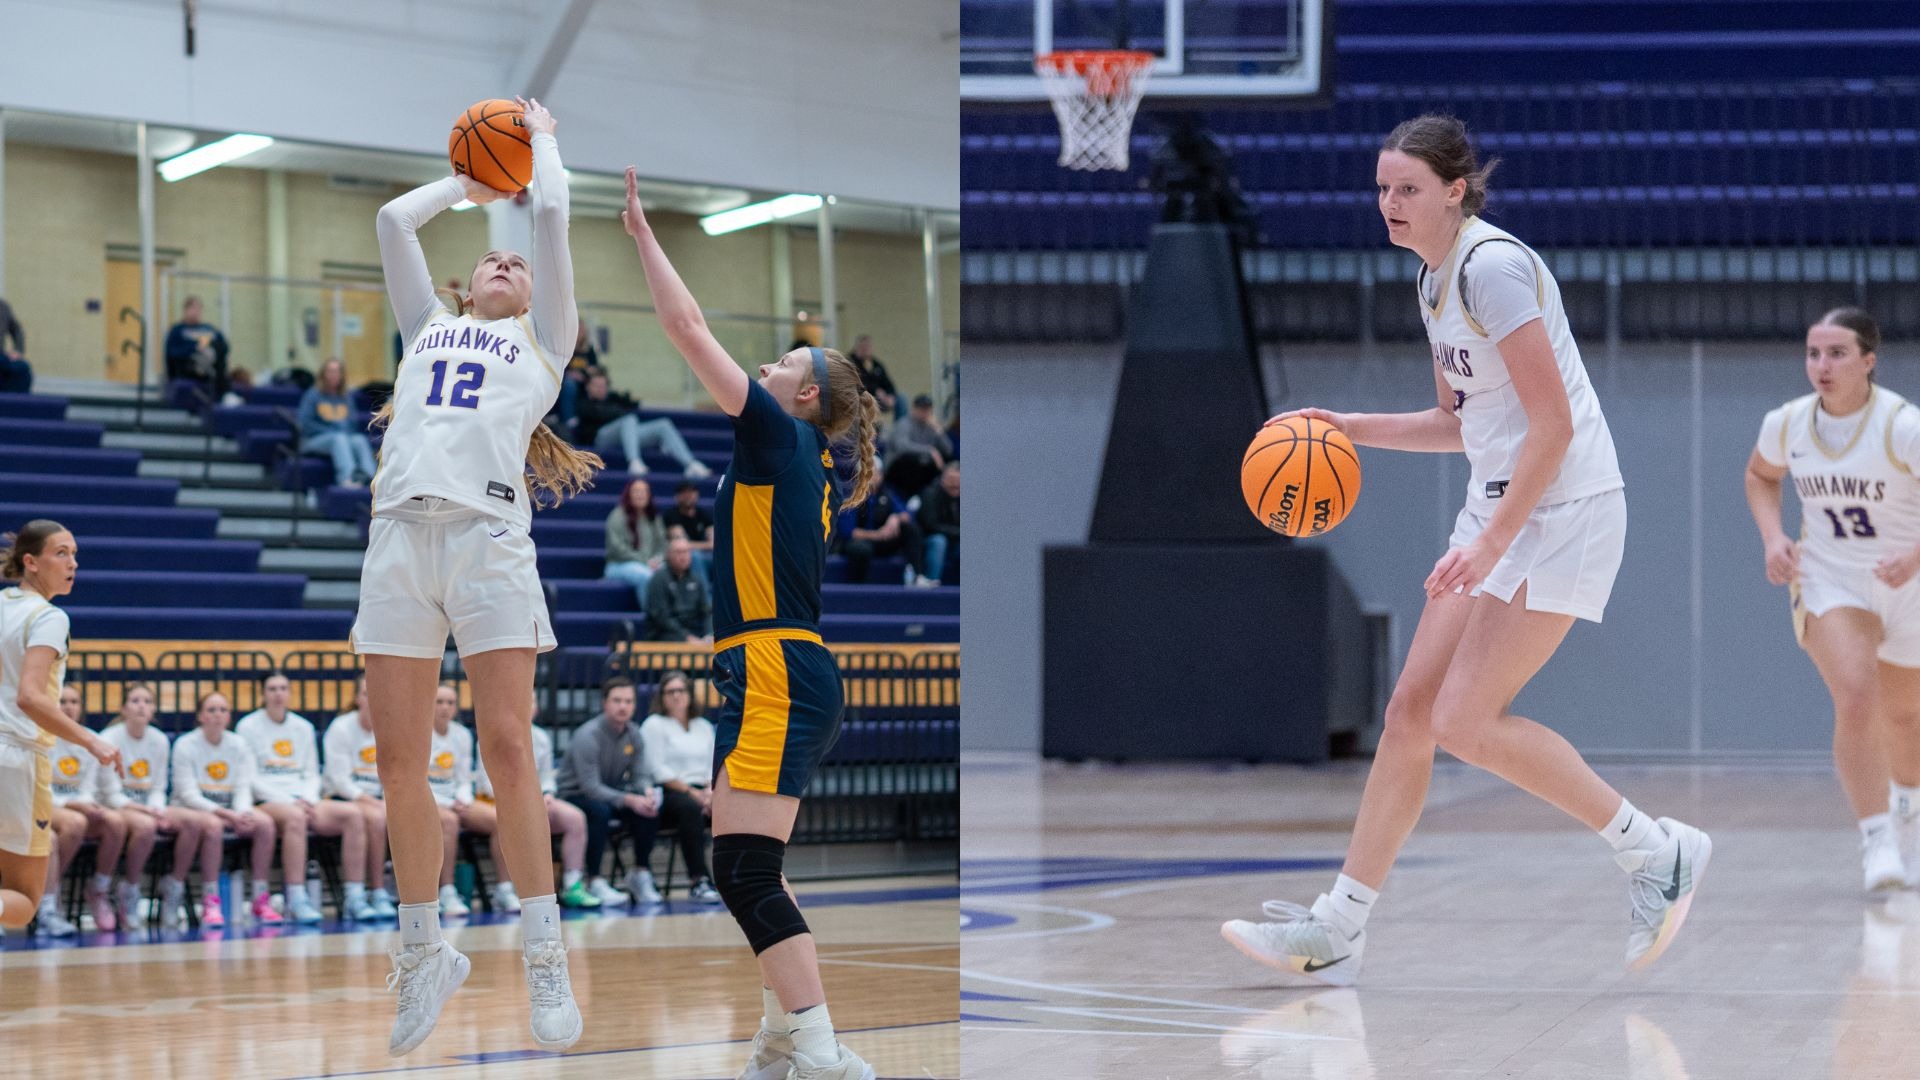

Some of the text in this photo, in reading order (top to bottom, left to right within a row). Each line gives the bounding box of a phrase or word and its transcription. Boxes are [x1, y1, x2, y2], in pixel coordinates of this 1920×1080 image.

[426, 360, 486, 409] 12
[1310, 498, 1332, 535] CAA
[1823, 507, 1876, 538] 13
